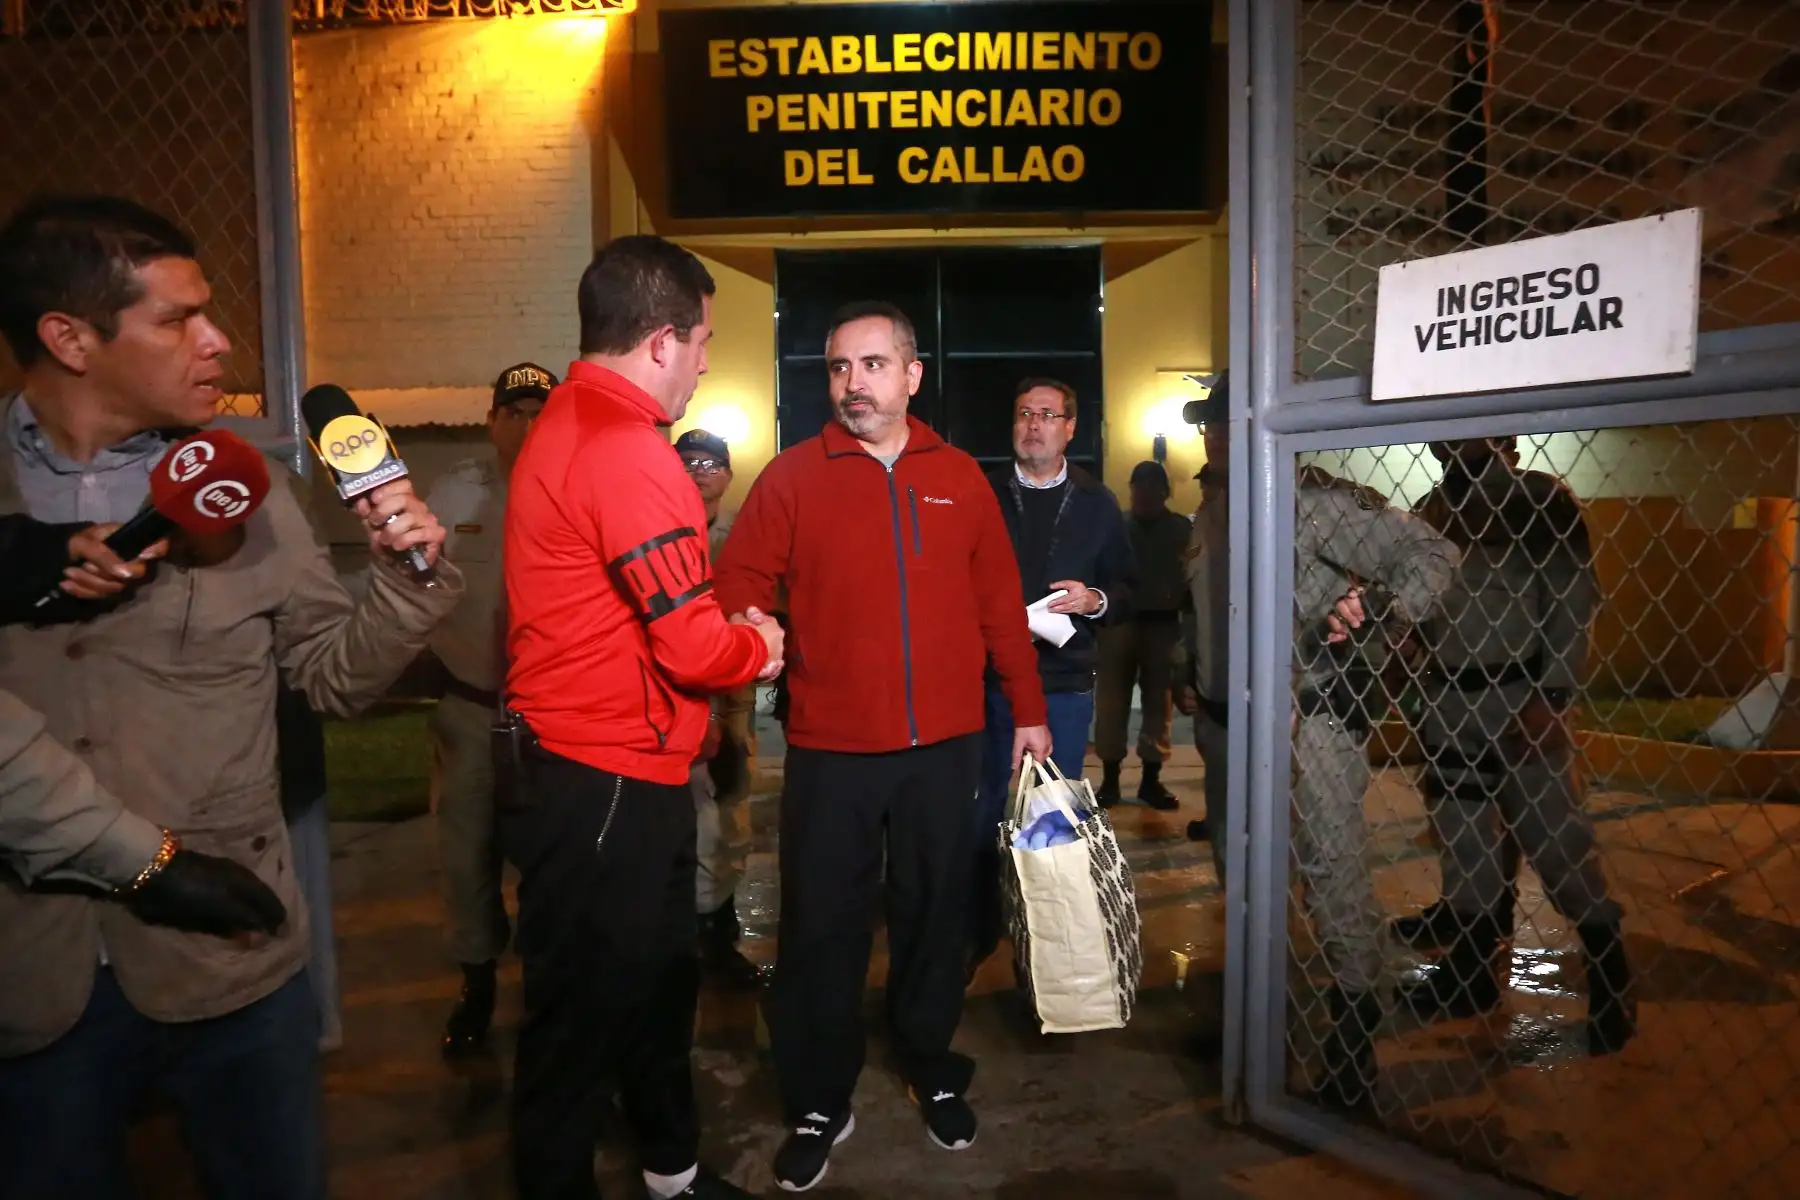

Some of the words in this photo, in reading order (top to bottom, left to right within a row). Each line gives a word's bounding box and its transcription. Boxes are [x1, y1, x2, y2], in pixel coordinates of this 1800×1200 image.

[708, 31, 1163, 78] ESTABLECIMIENTO
[746, 88, 1122, 133] PENITENCIARIO
[784, 149, 874, 187] DEL
[898, 144, 1086, 184] CALLAO
[1437, 263, 1600, 316] INGRESO
[1414, 296, 1624, 353] VEHICULAR
[505, 367, 551, 390] INPE
[329, 429, 377, 461] RPP
[343, 464, 400, 492] NOTICIAS
